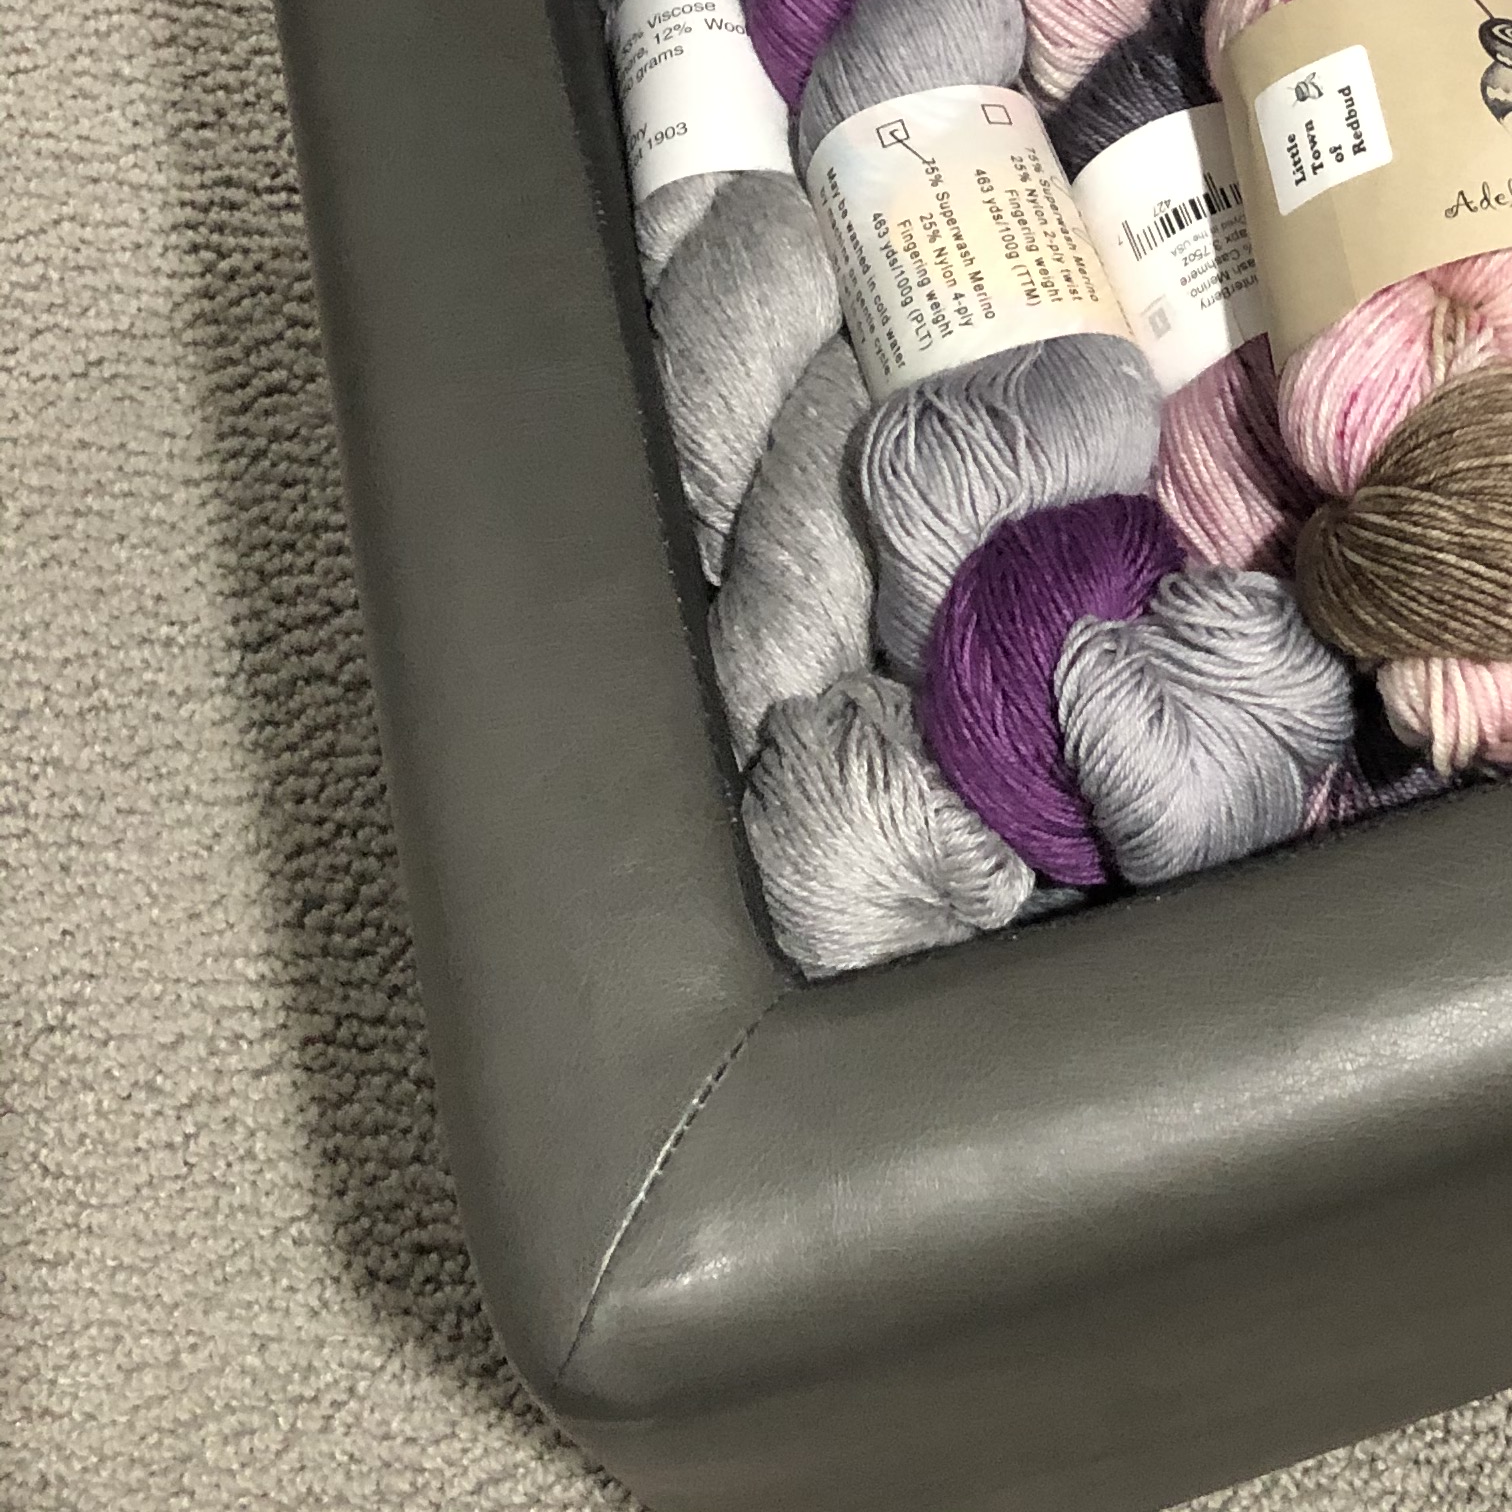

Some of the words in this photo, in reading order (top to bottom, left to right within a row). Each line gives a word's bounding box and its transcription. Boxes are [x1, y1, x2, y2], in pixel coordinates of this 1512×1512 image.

[647, 1, 716, 29] Viscose
[654, 22, 692, 45] 12%
[636, 45, 684, 83] grams
[647, 121, 688, 151] 1903
[1338, 85, 1367, 156] Redbud
[1287, 133, 1306, 186] Little
[1304, 120, 1324, 175] Town
[1329, 144, 1344, 162] of
[974, 168, 994, 193] 463
[872, 212, 890, 239] 463
[922, 157, 943, 187] 75%
[936, 191, 975, 268] Superwash
[968, 270, 996, 320] Merino
[982, 197, 1020, 260] yds/100g
[1005, 189, 1040, 252] Fingering
[1035, 257, 1063, 303] weight
[1010, 155, 1031, 183] 25%
[1025, 188, 1048, 226] Nylon
[1043, 230, 1065, 264] 2-ply
[1061, 269, 1083, 301] twist
[1039, 178, 1077, 252] Superwash
[1073, 255, 1099, 302] Merino
[1171, 240, 1191, 257] USA
[827, 167, 840, 199] May
[838, 199, 848, 219] be
[846, 220, 872, 276] washed
[867, 275, 877, 293] in
[873, 294, 892, 327] cold
[886, 327, 906, 369] water
[879, 240, 914, 308] yds/100g
[897, 219, 931, 288] Fingering
[926, 289, 954, 339] weight
[919, 212, 941, 244] 25%
[933, 247, 957, 289] Nylon
[952, 291, 974, 328] 4-ply
[1011, 264, 1042, 307] (TTM)
[1180, 249, 1240, 286] Cashmere
[856, 290, 876, 335] gentle
[907, 308, 934, 352] (PLT)
